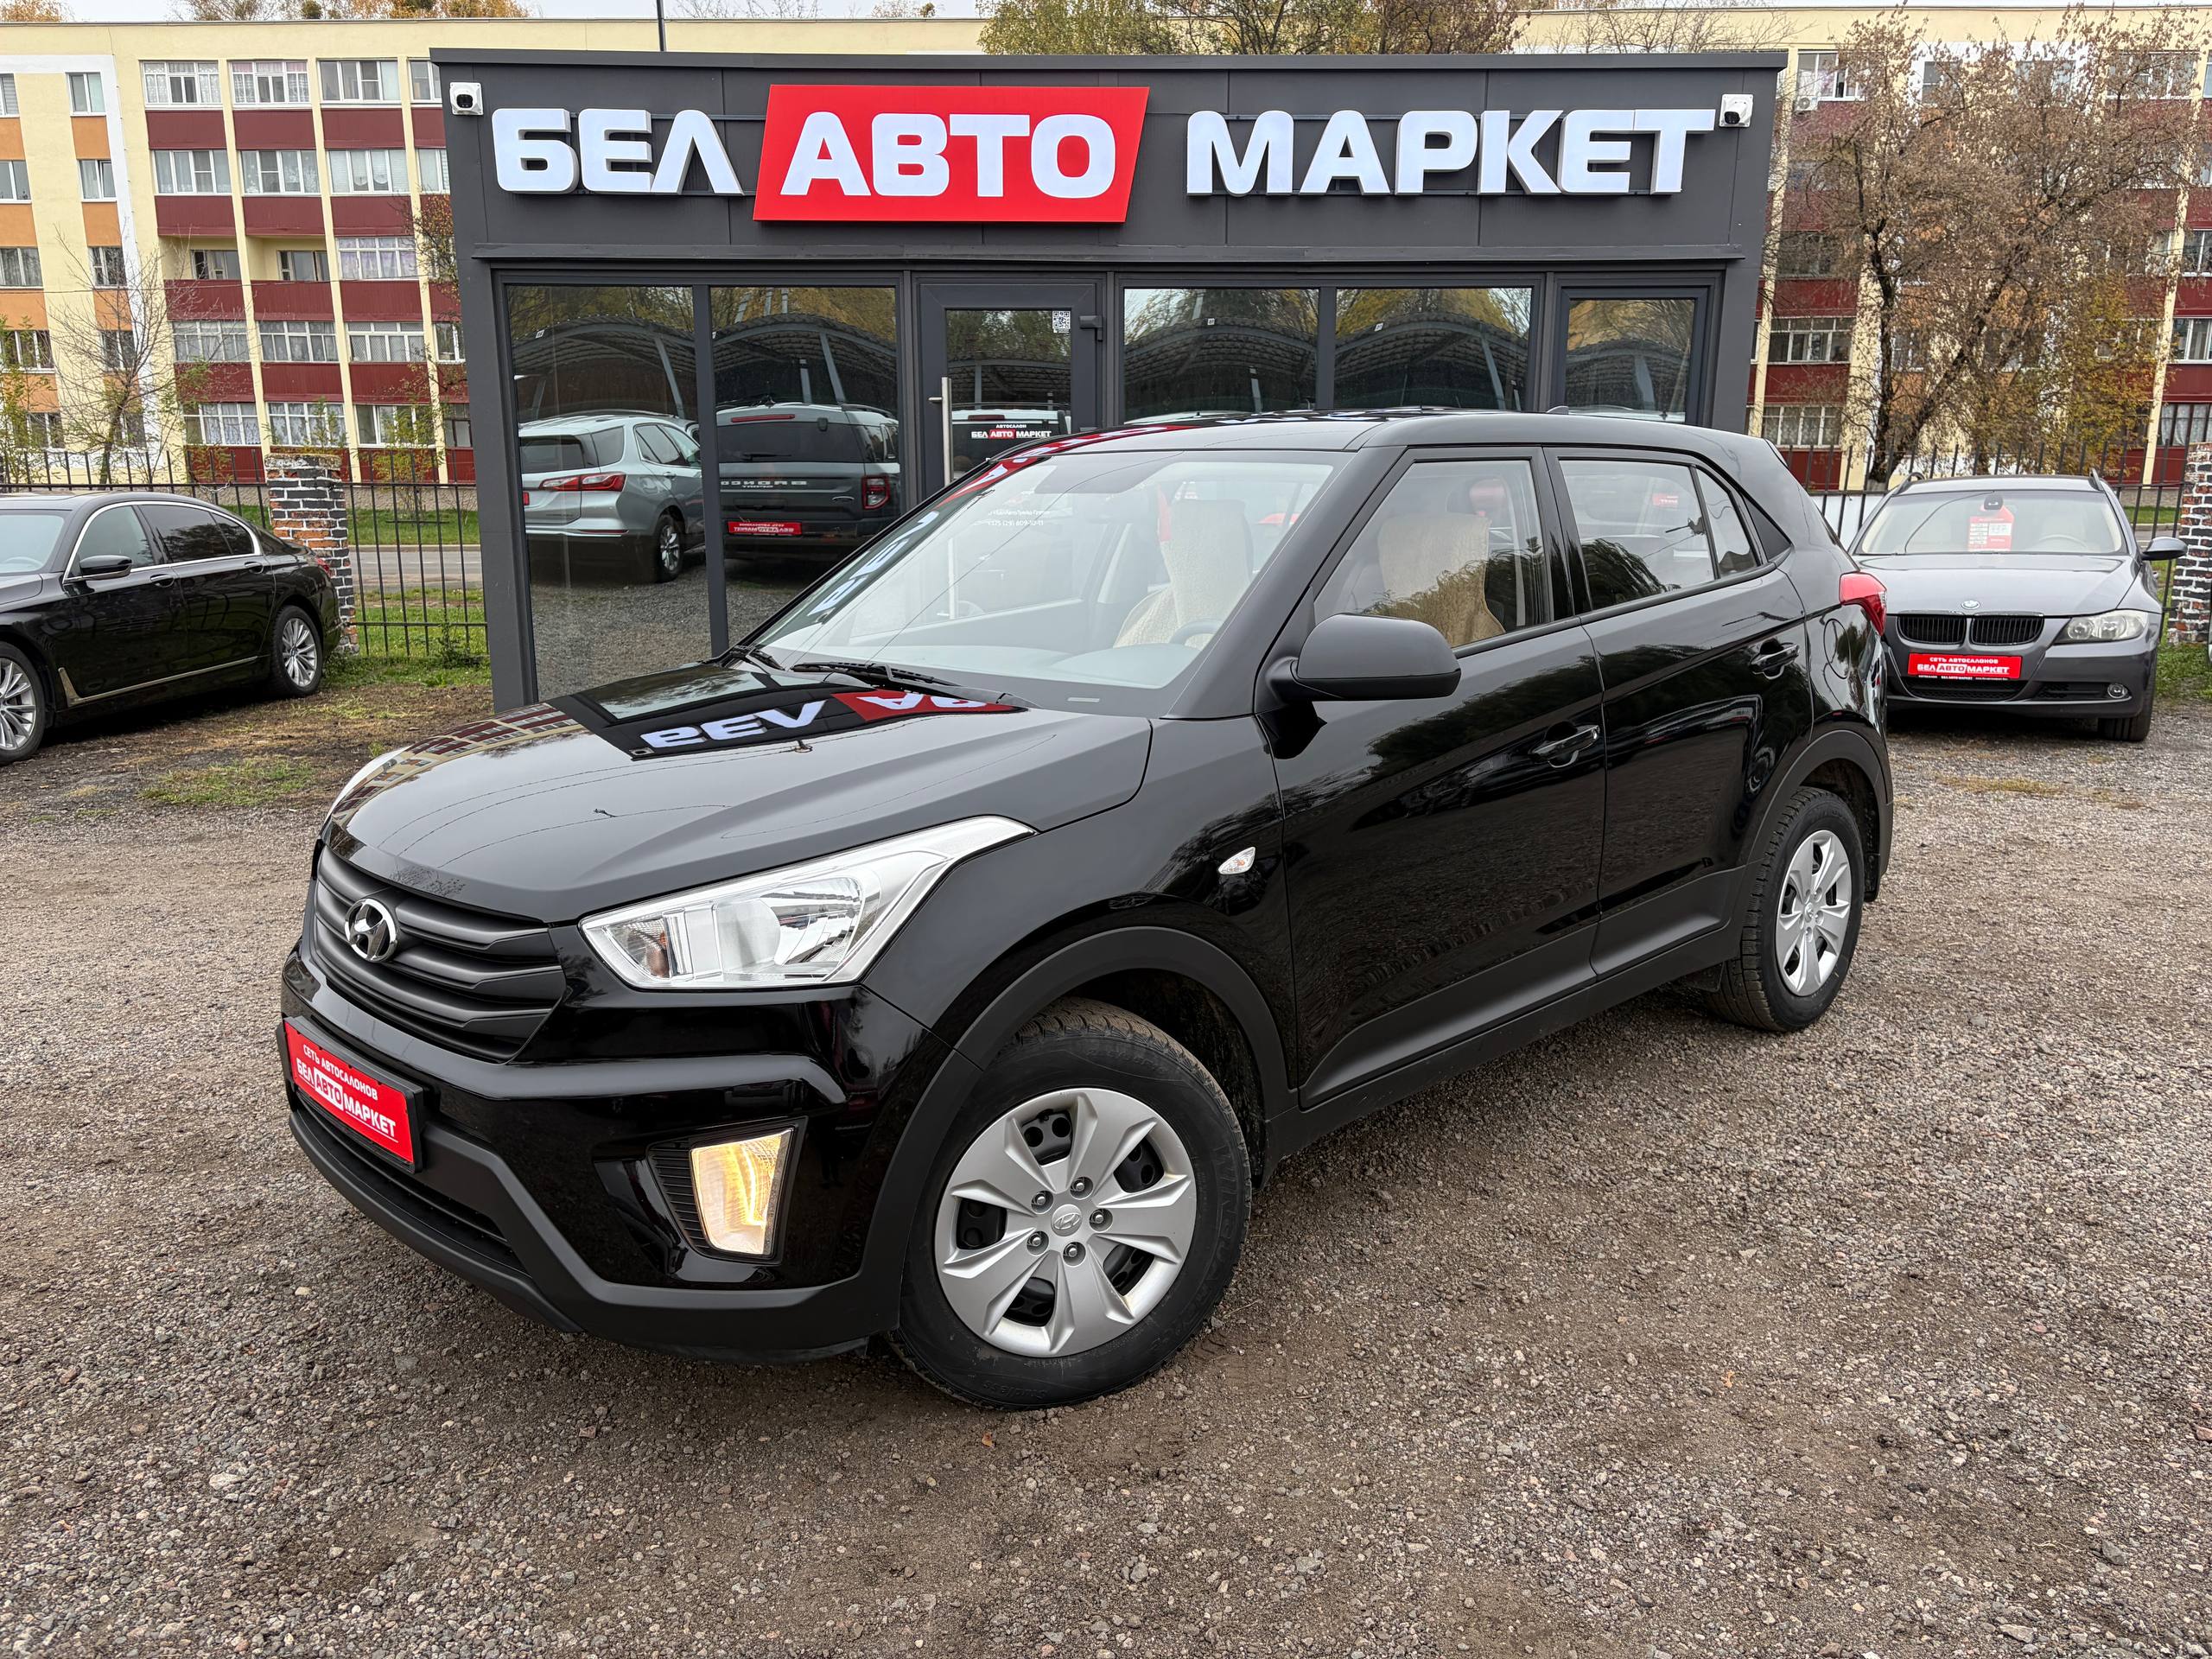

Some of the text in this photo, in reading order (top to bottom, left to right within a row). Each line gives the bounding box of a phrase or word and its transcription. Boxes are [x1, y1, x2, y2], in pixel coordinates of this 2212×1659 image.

[492, 107, 1717, 200] БЕЛ АВТО МАРКЕТ
[970, 429, 1052, 439] БЕЛ АВТО МАРКЕТ
[1916, 664, 2010, 674] БЕЛ АВТО МАРКЕТ
[296, 1057, 397, 1138] БЕЛ АВТО МАРКЕТ
[302, 1044, 378, 1101] СЕТЬ АВТОСАЛОНОВ
